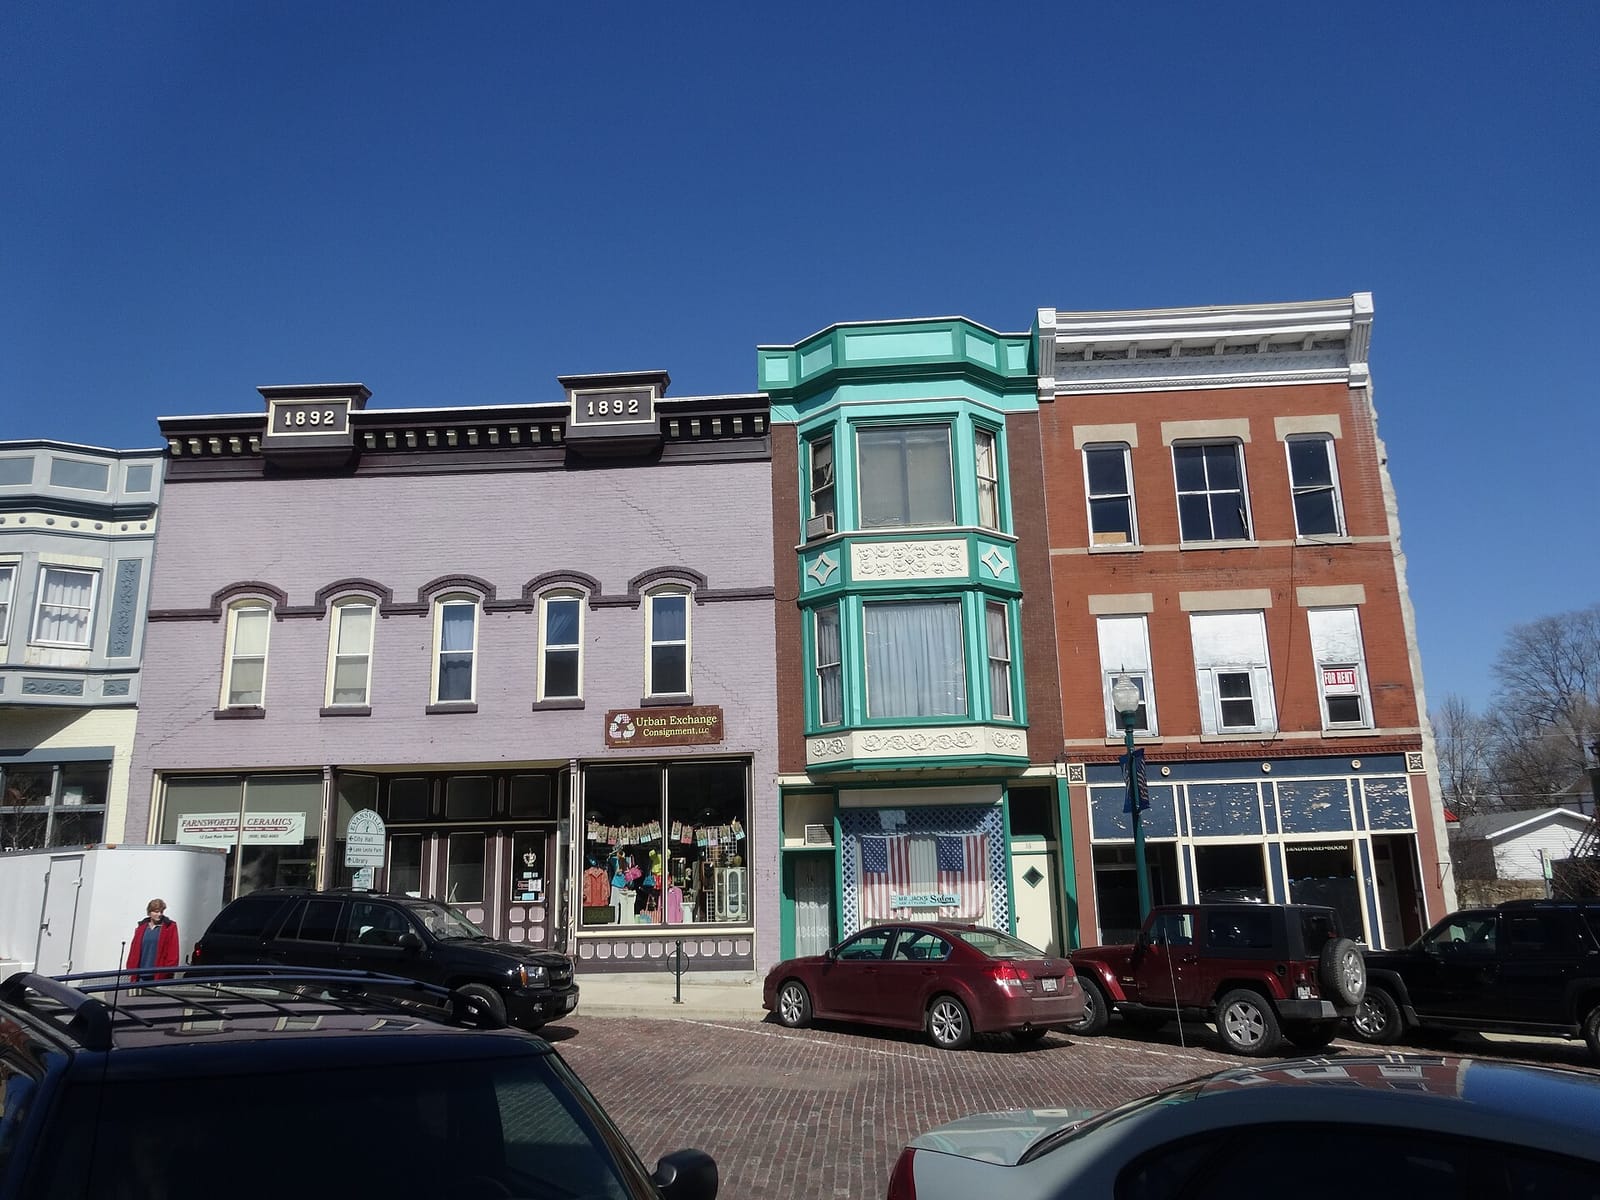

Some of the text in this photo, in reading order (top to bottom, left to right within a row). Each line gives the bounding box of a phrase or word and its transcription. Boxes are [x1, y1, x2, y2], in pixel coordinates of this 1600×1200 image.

[588, 400, 638, 415] 1892
[285, 411, 334, 425] 1892
[1324, 671, 1353, 684] FOR RENT
[636, 715, 718, 727] Urban Exchange
[182, 818, 293, 827] FARNSWORTH CERAMICS
[350, 812, 384, 832] EVANSVILLE
